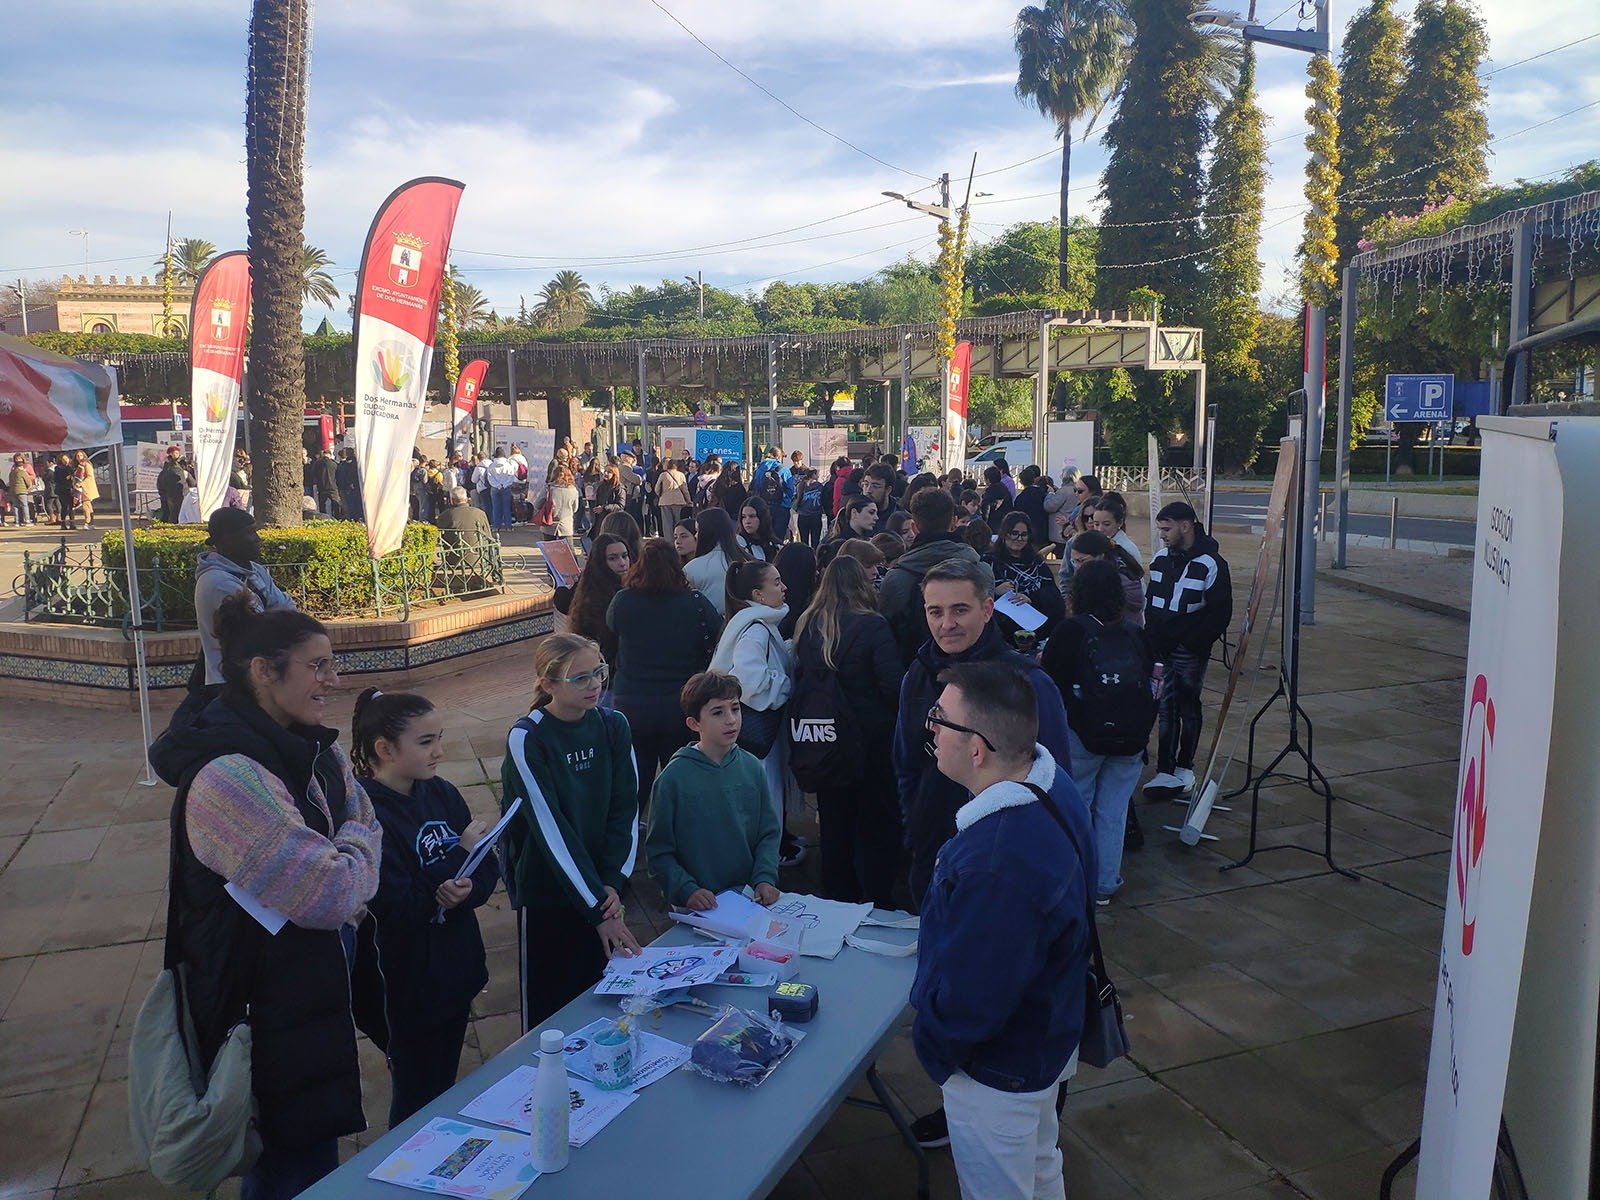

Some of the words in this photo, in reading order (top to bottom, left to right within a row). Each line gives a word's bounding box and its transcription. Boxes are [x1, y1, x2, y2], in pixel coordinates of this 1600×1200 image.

[364, 393, 379, 402] Dos
[380, 396, 417, 409] Hermanas
[1425, 384, 1442, 406] P
[363, 402, 386, 411] CIUDAD
[363, 409, 400, 420] EDUCADORA
[791, 718, 837, 742] VANS
[566, 748, 594, 764] FILA
